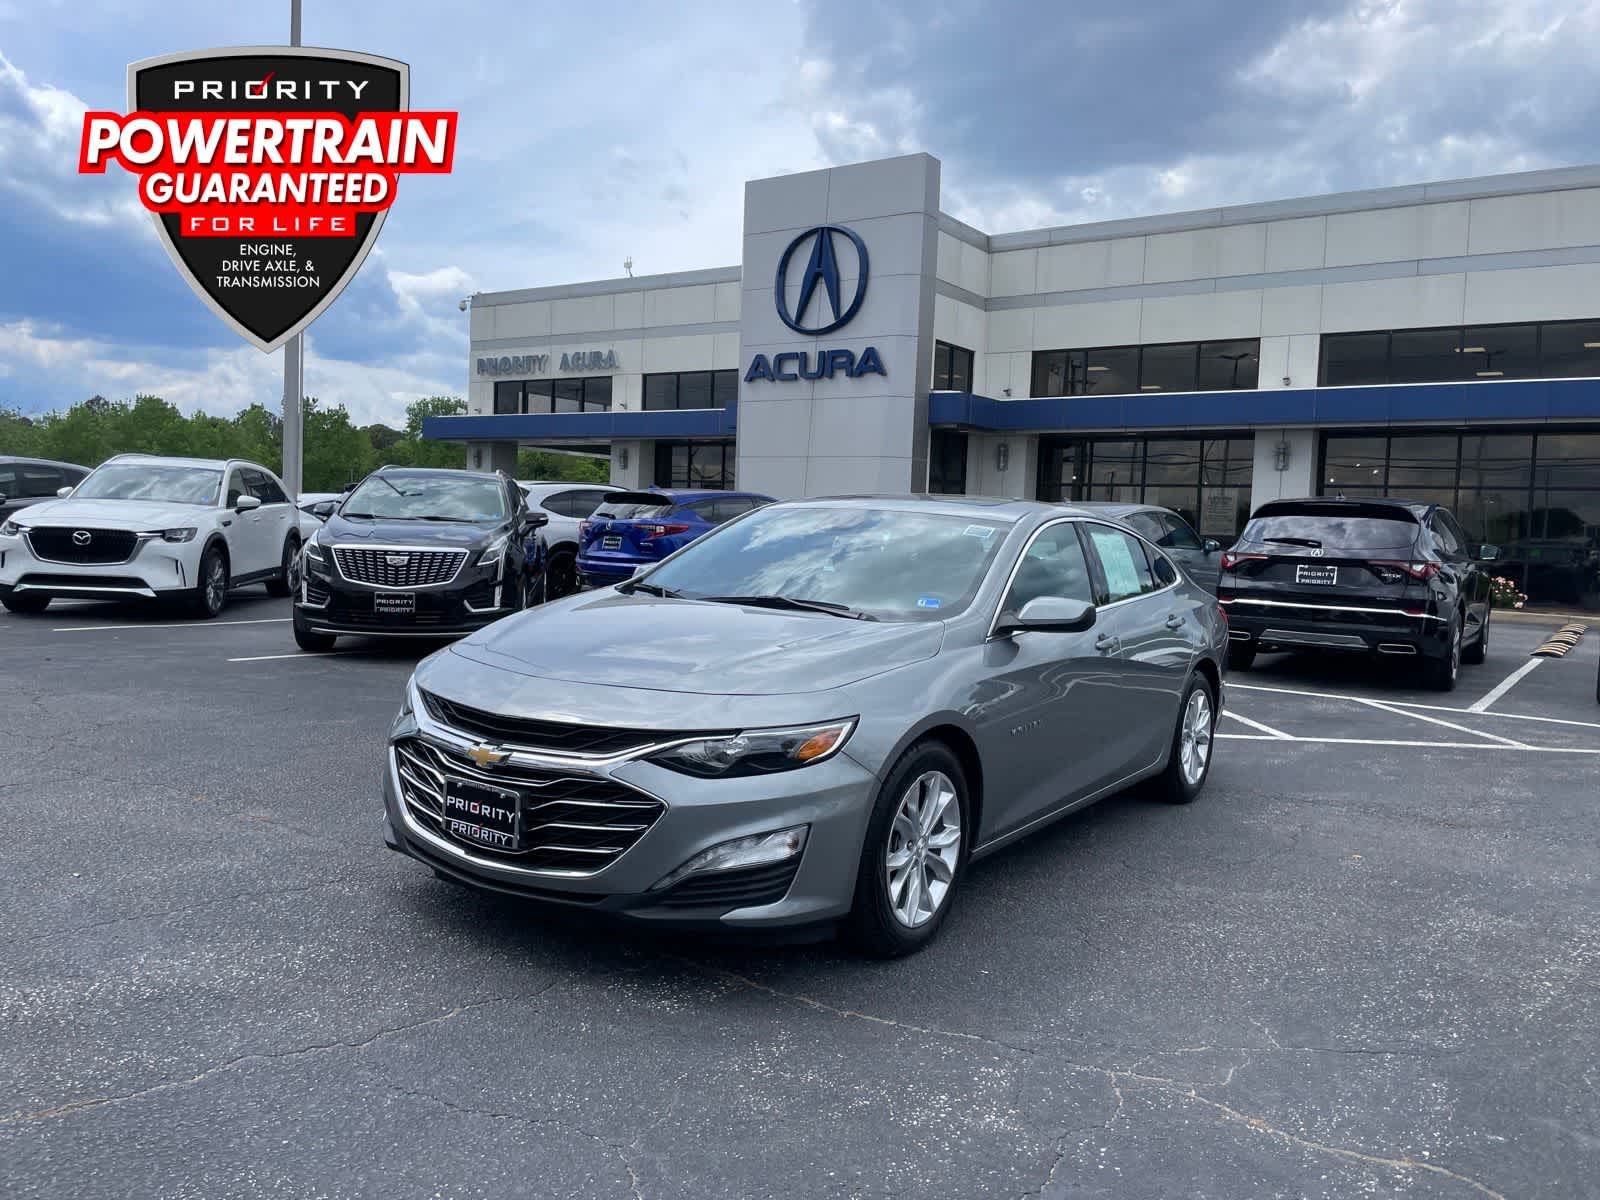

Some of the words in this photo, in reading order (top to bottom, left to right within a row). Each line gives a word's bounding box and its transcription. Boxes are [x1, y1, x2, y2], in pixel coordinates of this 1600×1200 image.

[477, 353, 548, 376] PRIORITY
[559, 349, 620, 371] ACURA
[743, 346, 888, 382] ACURA
[446, 796, 514, 823] PRIORITY
[451, 821, 508, 845] PRIORITY
